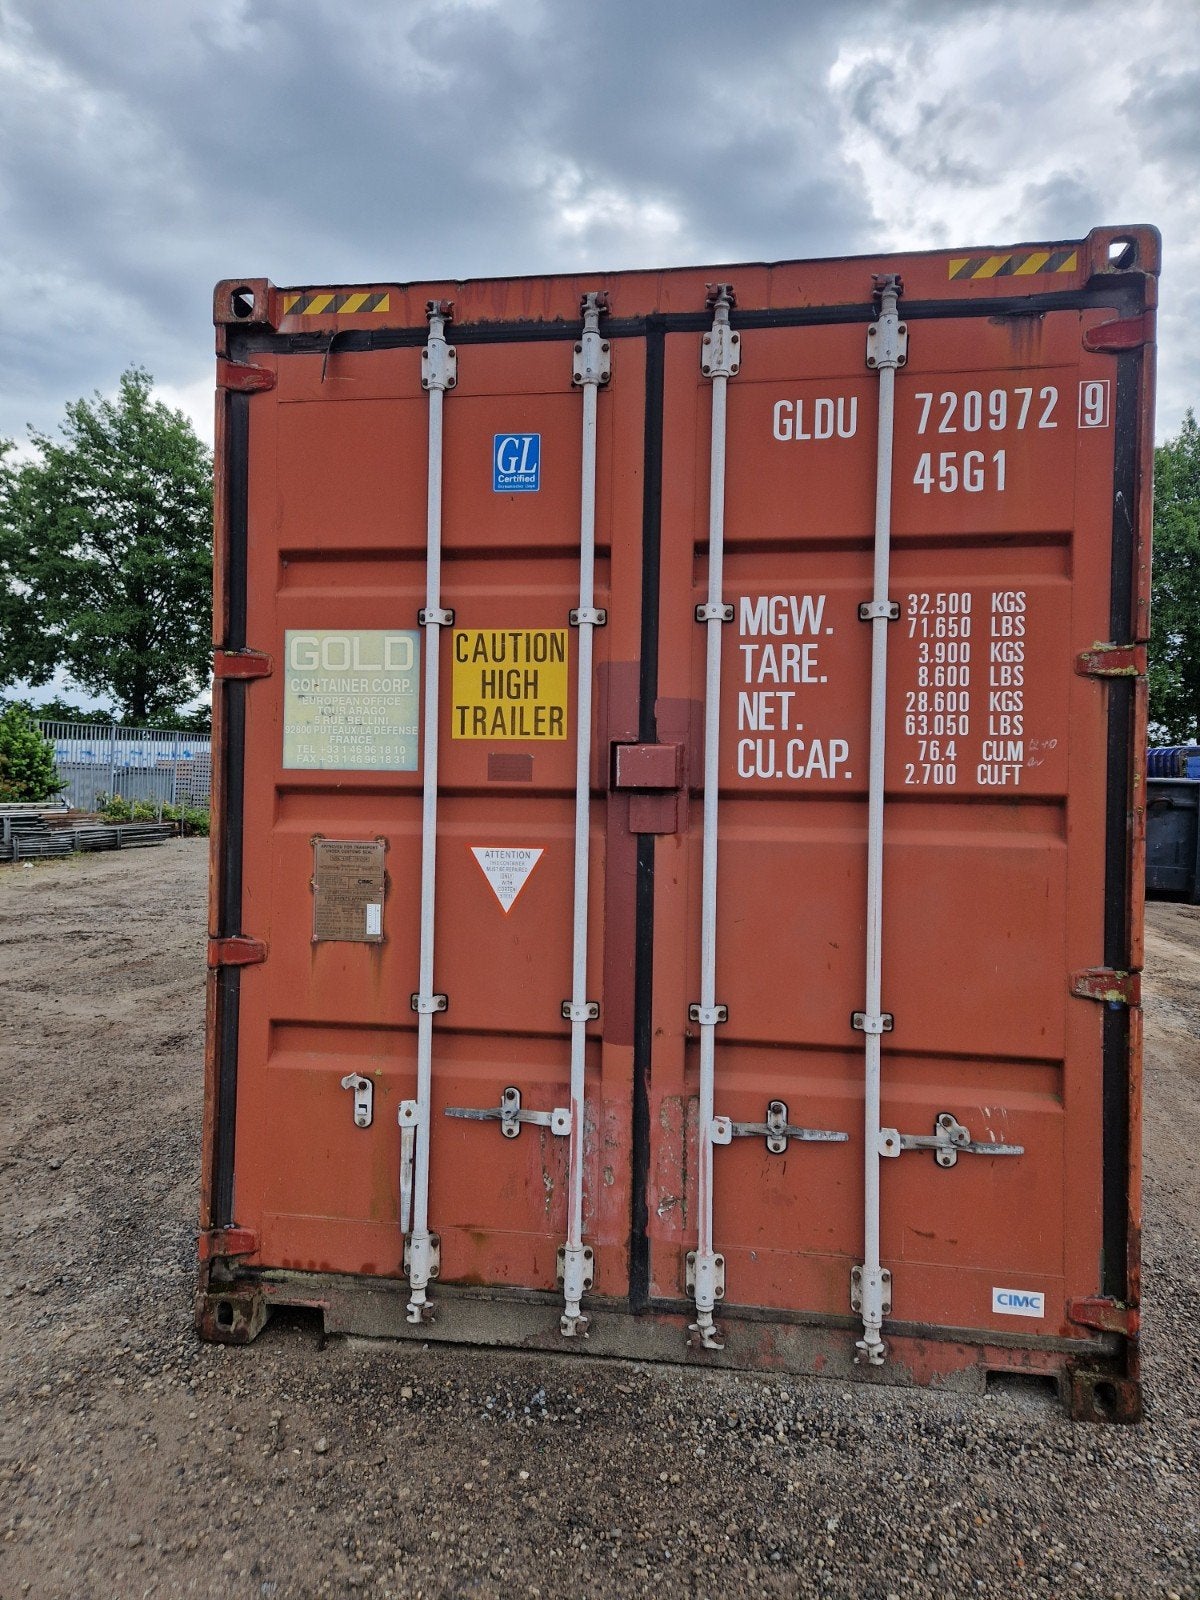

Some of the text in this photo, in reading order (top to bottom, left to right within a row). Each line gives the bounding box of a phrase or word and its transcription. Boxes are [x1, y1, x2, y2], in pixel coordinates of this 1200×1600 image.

[773, 383, 1104, 441] GLDU 720972 9
[497, 437, 537, 474] GL
[498, 475, 536, 483] Certified
[913, 449, 1006, 494] 45G1
[991, 591, 1027, 613] KGS
[739, 595, 834, 636] MGW.
[991, 615, 1026, 637] LBS
[290, 636, 414, 671] GOLD
[456, 632, 565, 663] CAUTION
[990, 641, 1025, 662] KGS
[739, 643, 828, 683] TARE.
[291, 678, 414, 693] CONTAINER CORP.
[481, 669, 538, 699] HIGH
[989, 665, 1024, 686] LBS
[302, 697, 401, 706] EUROPEAN OFFICE
[318, 706, 386, 715] TOUR ARAGO
[738, 691, 804, 731] NET.
[989, 690, 1024, 712] KGS
[323, 716, 346, 725] RUE
[347, 716, 389, 725] BELLINI
[374, 726, 418, 735] DEFENSE
[456, 706, 564, 736] TRAILER
[989, 714, 1024, 736] LBS
[296, 745, 315, 754] TEL
[350, 745, 364, 754] 46
[365, 745, 377, 754] 96
[380, 745, 391, 754] 18
[395, 745, 406, 754] 10
[329, 735, 372, 744] FRANCE
[296, 754, 316, 763] FAX
[350, 754, 364, 763] 46
[365, 754, 377, 763] 96
[380, 754, 391, 763] 18
[394, 754, 405, 763] 31
[737, 738, 852, 779] CU.CAP.
[918, 740, 957, 762] 76.4
[982, 740, 1024, 762] CU.M
[977, 764, 1023, 785] CU.FT
[484, 850, 531, 859] ATTENTION
[997, 1293, 1041, 1309] CIMC
